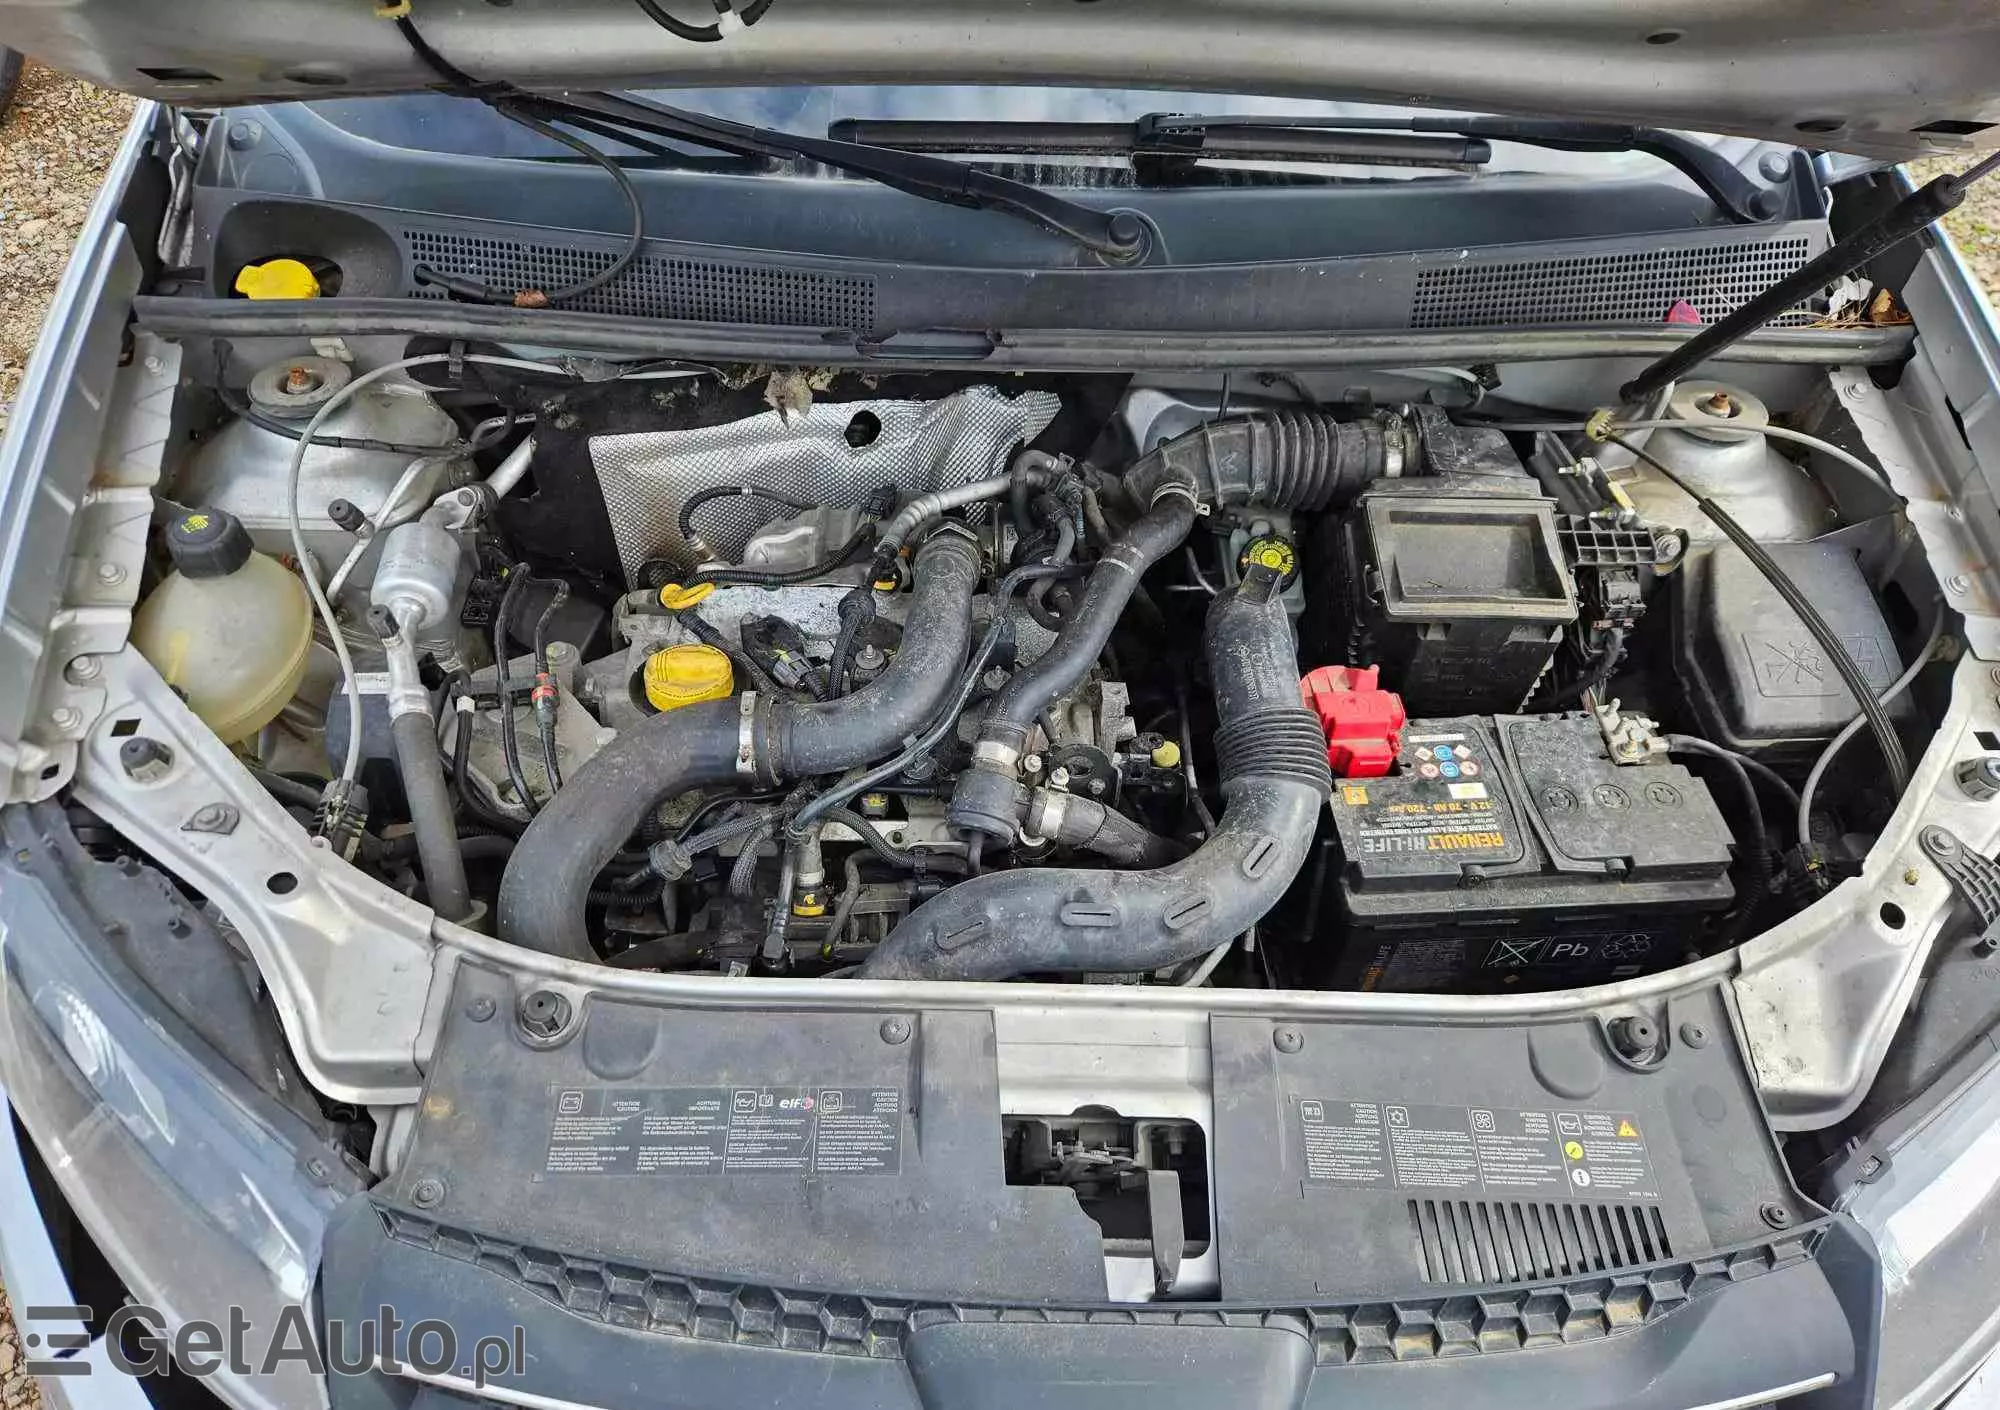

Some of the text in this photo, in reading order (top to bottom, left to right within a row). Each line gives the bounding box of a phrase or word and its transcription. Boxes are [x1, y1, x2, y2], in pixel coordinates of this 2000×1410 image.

[1363, 832, 1504, 853] RENAULT Hi-LIFE
[1552, 943, 1589, 957] Pb
[779, 1097, 803, 1109] elf
